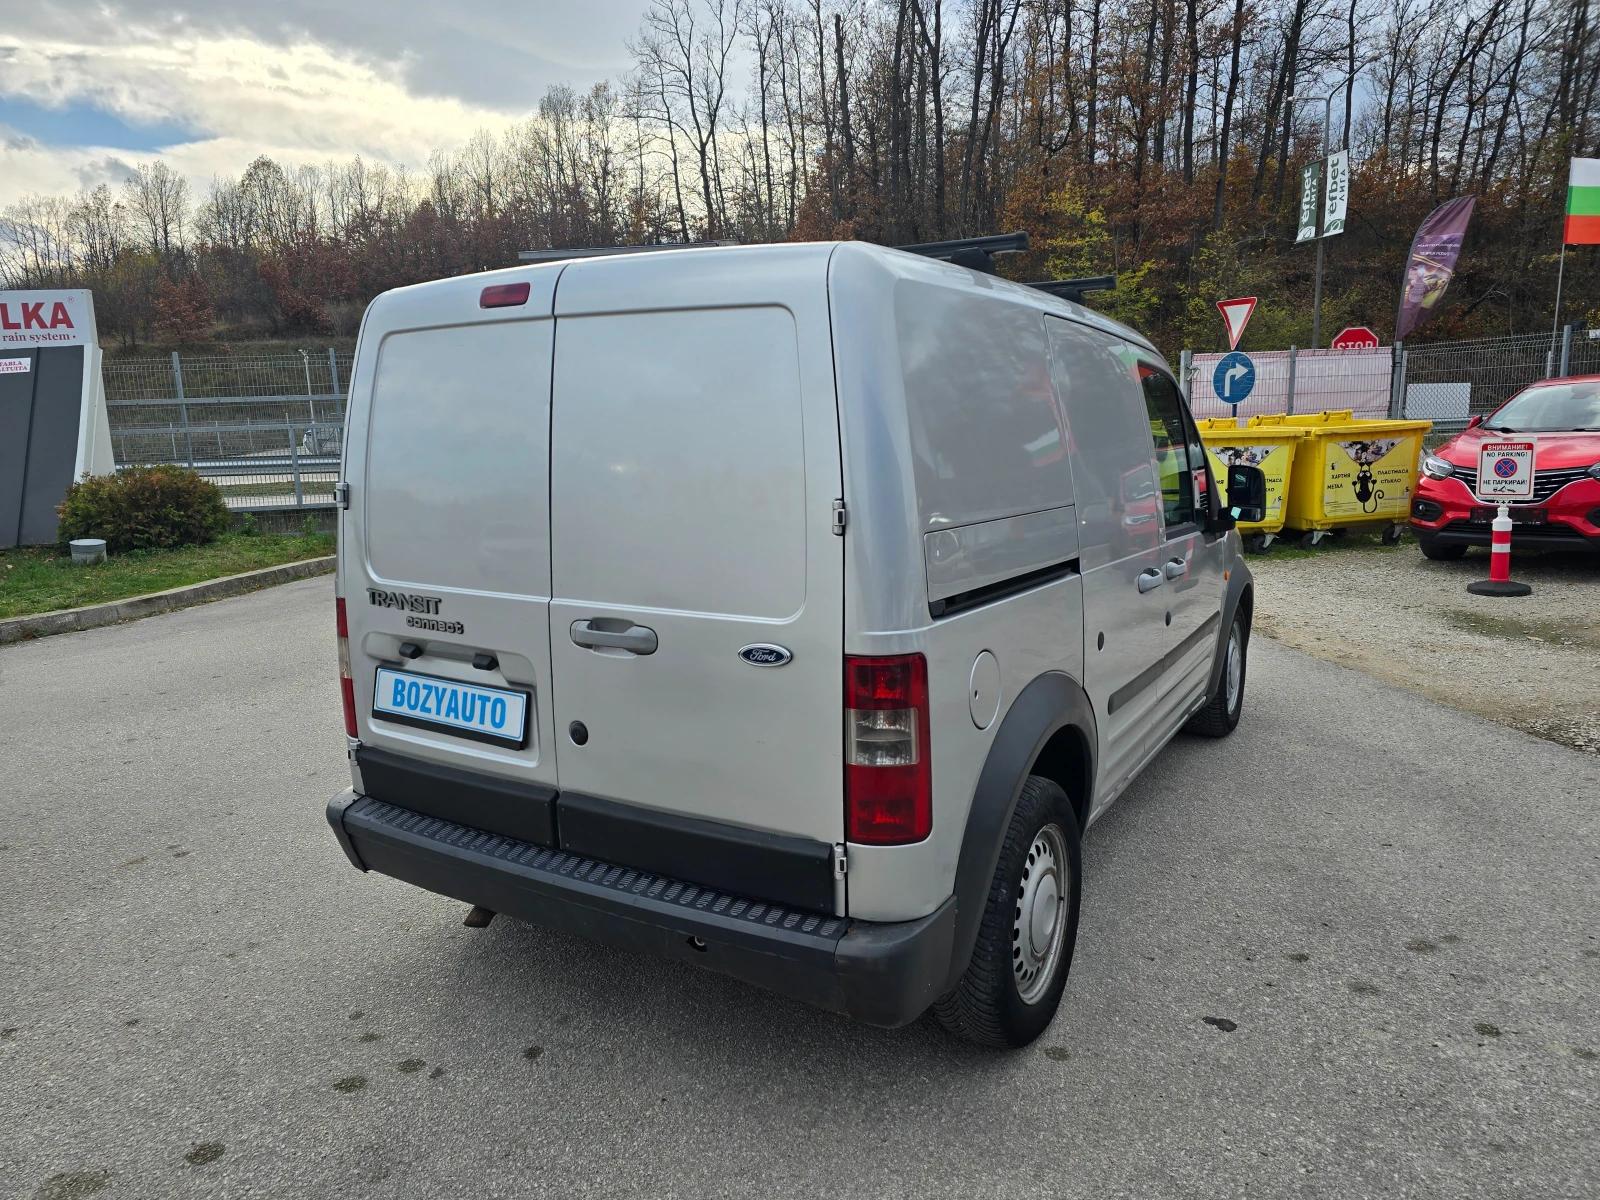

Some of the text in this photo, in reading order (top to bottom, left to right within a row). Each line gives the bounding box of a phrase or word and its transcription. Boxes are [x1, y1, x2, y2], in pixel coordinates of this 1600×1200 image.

[1302, 167, 1312, 223] efbet
[1329, 157, 1340, 215] efbet
[2, 332, 70, 343] rain system
[366, 588, 442, 615] TRANSIT
[406, 616, 464, 634] connect
[749, 648, 777, 662] Ford
[392, 678, 506, 729] BOZYAUTO
